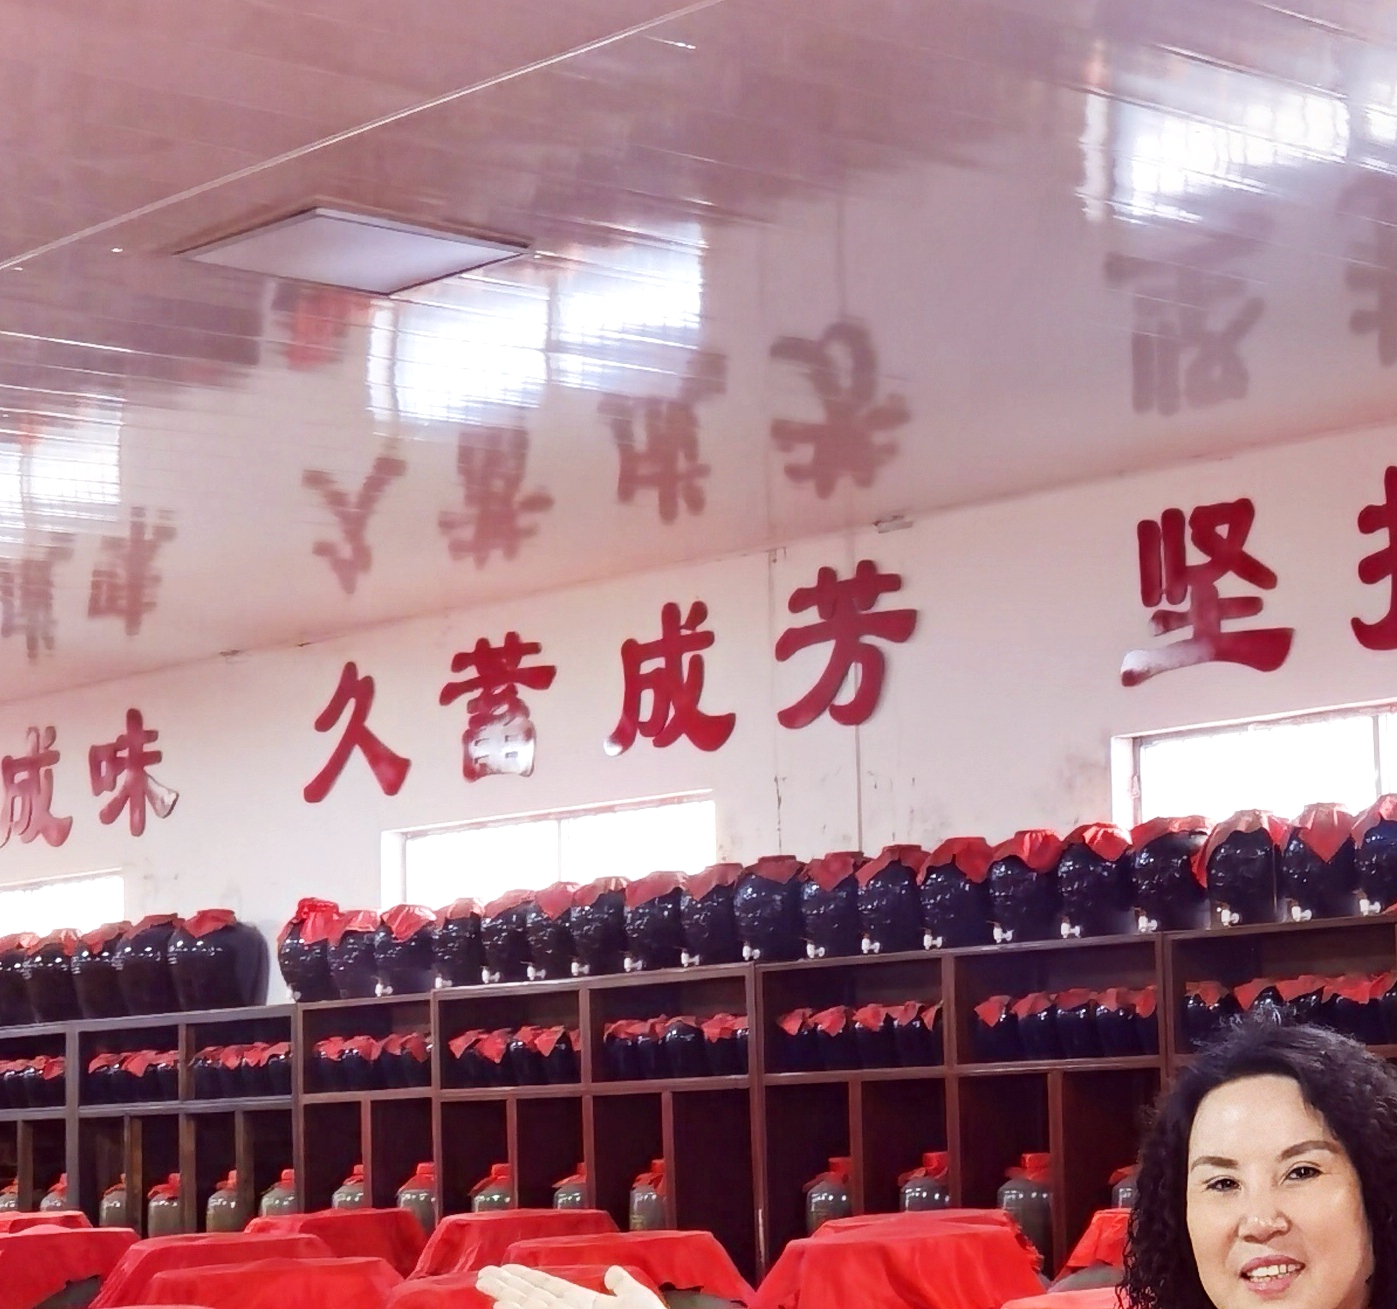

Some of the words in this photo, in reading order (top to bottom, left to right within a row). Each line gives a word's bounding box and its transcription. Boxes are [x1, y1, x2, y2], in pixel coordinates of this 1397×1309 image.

[303, 559, 918, 804] 久蓄成芳
[0, 708, 179, 848] 成味
